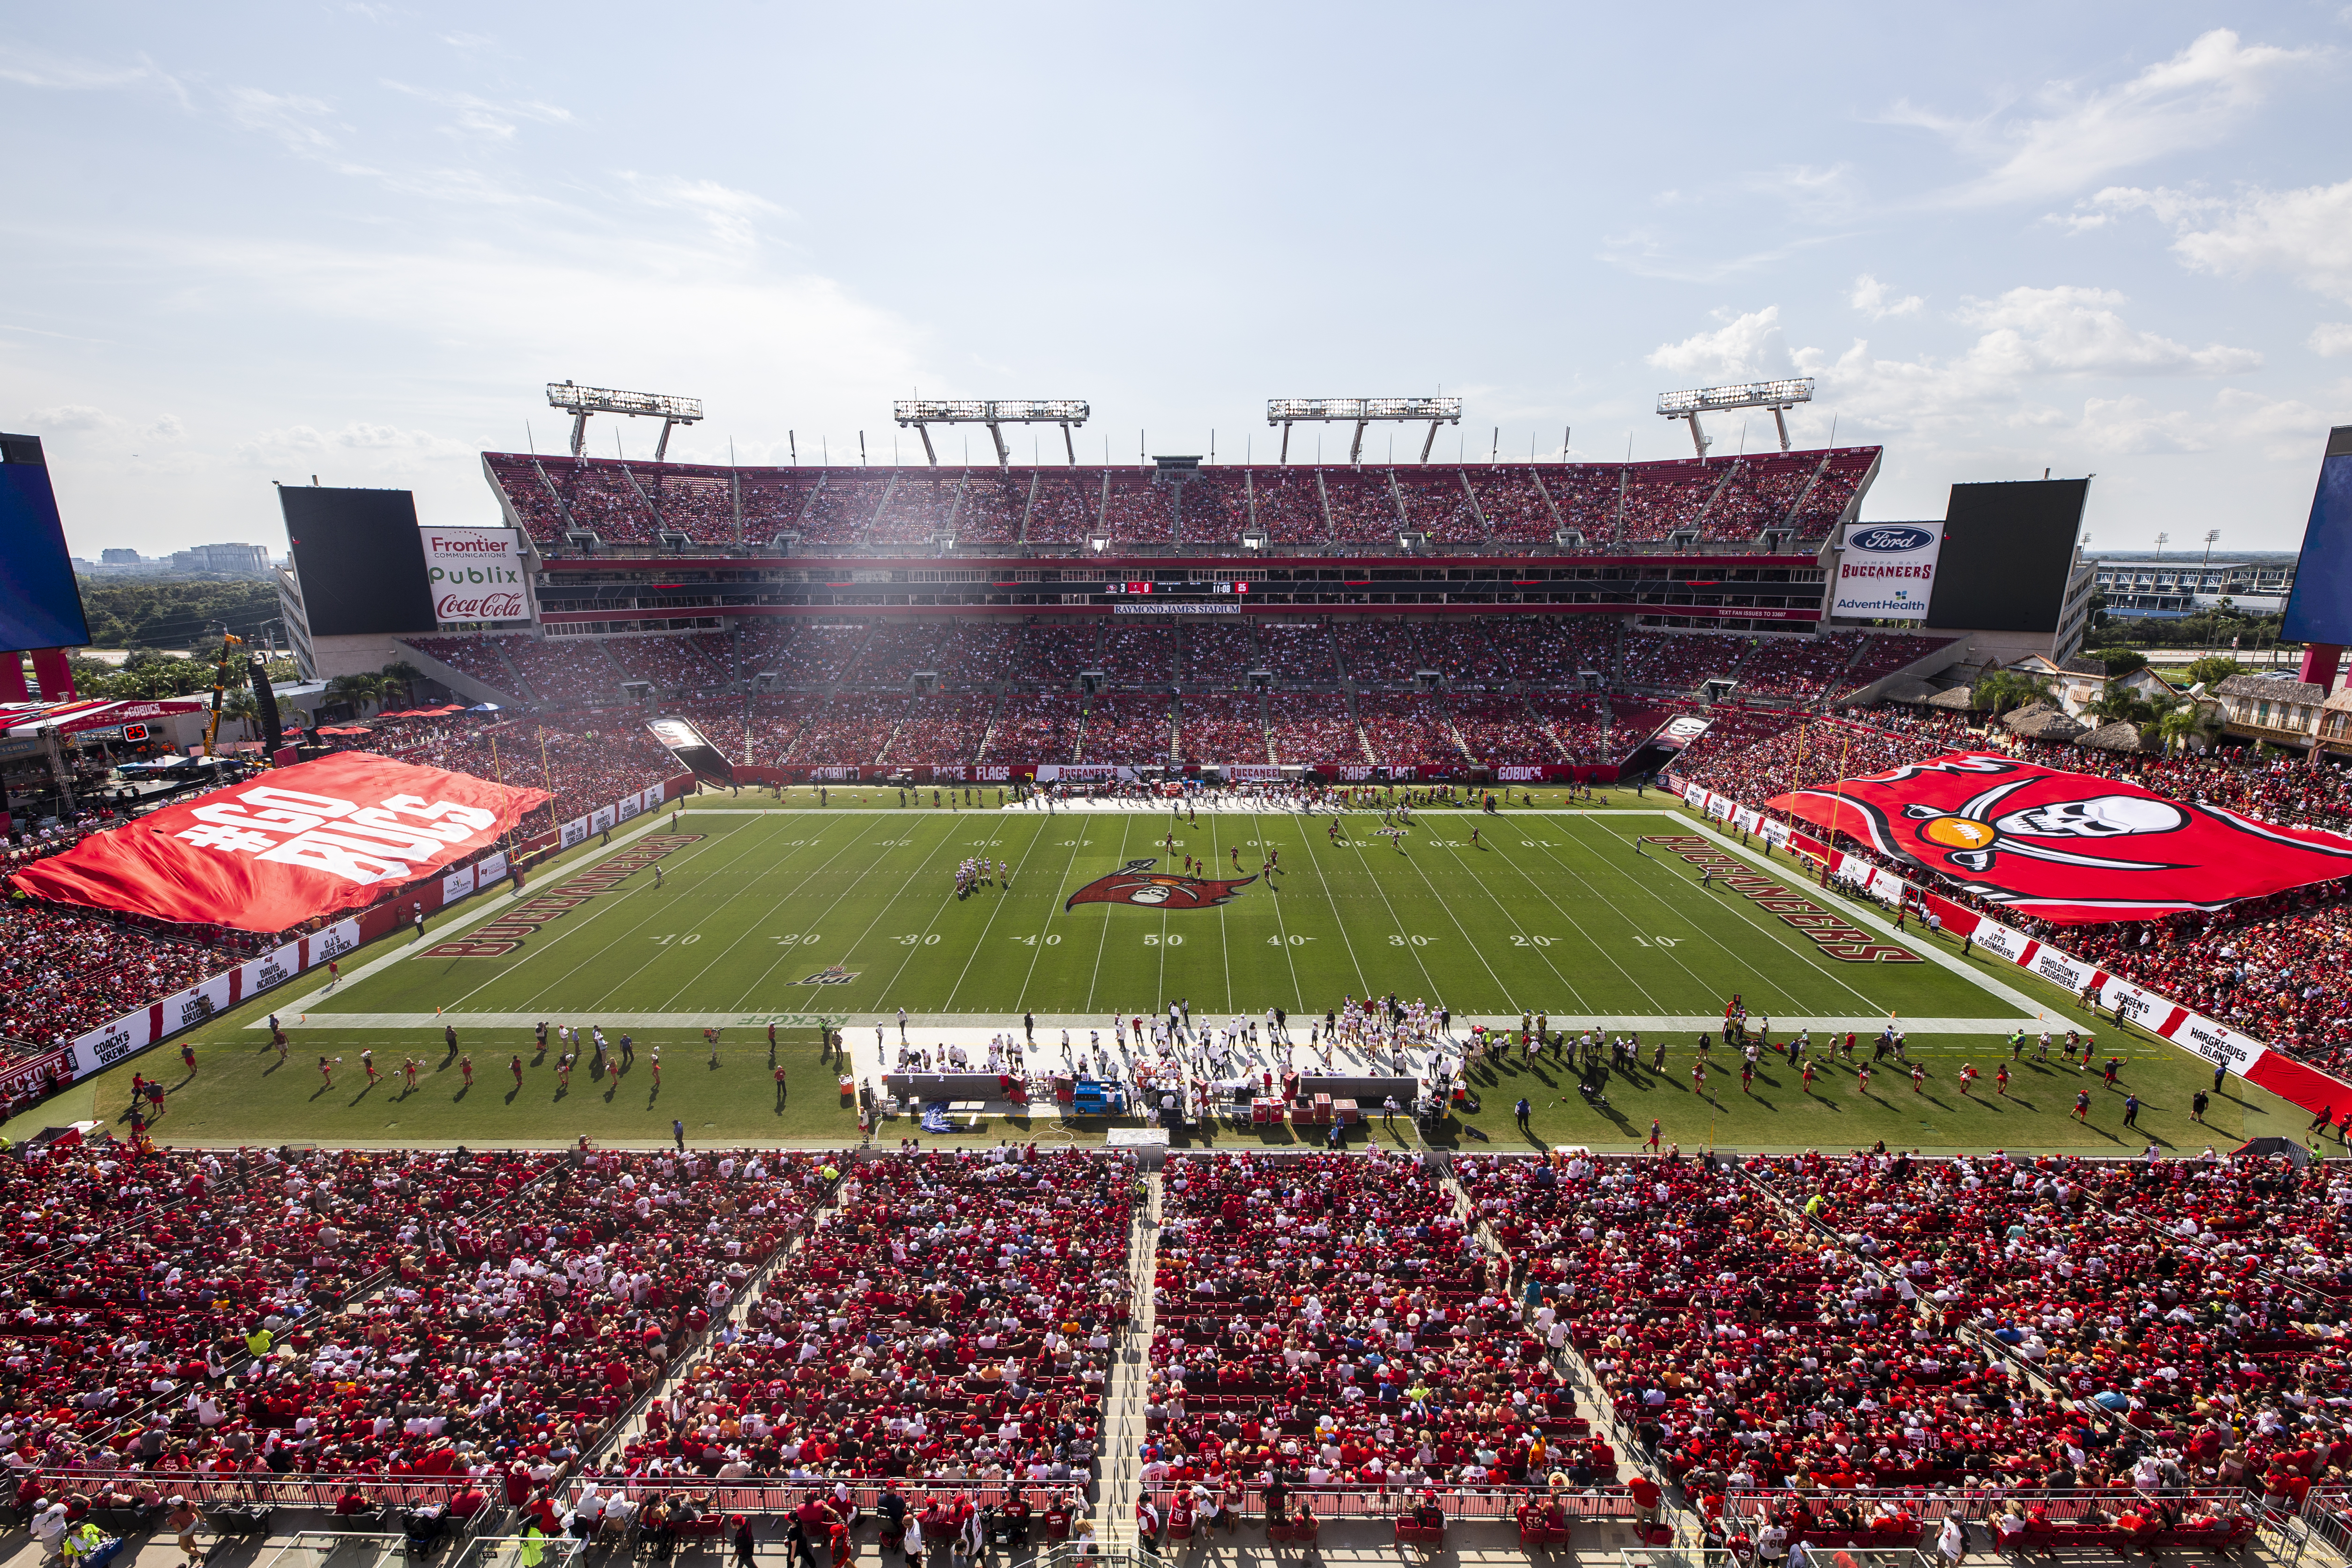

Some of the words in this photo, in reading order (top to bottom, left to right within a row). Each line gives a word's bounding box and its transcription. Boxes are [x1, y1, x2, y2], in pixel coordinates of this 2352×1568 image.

[432, 537, 508, 552] Frontier
[1865, 531, 1916, 547] Ford
[429, 566, 518, 584] Publix
[1842, 564, 1933, 582] BUCCANEERS
[1120, 584, 1125, 592] 3
[1144, 584, 1149, 592] 0
[1238, 583, 1246, 592] 25
[437, 592, 524, 618] Coca-Cola
[124, 703, 160, 717] #GOBUCS
[127, 727, 144, 739] 25
[2254, 731, 2294, 740] GALLEY
[976, 767, 1010, 780] FLAGS
[1058, 767, 1117, 779] BUCCANEERS
[1339, 767, 1373, 780] RAISE
[1669, 778, 1682, 793] KICKOFF
[254, 794, 497, 886] BUCS
[565, 829, 576, 838] EVANS'
[567, 835, 576, 844] ZONE
[1763, 826, 1772, 835] JAMEIS
[1773, 830, 1787, 842] WINSTON'S
[509, 851, 518, 864] 25
[488, 863, 504, 872] BUCCANEERS
[489, 866, 505, 875] FOUNDATION
[411, 835, 703, 959] BUCCANEERS
[1642, 835, 1924, 963] BUCCANEERS
[1906, 888, 1917, 902] 25
[324, 935, 340, 948] O.J.'S
[655, 934, 701, 945] 10
[777, 934, 821, 945] 20
[900, 934, 941, 945] 30
[1021, 934, 1061, 945] 40
[1144, 935, 1183, 946] 50
[1267, 935, 1305, 946] 40
[1389, 935, 1427, 946] 30
[1510, 935, 1551, 946] 20
[1632, 935, 1675, 947] 10
[1990, 932, 2006, 945] J.P.P'S
[319, 945, 336, 961] JUICE
[337, 939, 351, 954] PACK
[1978, 935, 2014, 959] PLAYMAKERS
[259, 962, 280, 978] DAVIS
[2041, 955, 2079, 981] GHOLSTON'S
[256, 968, 288, 990] ACADEMY
[2039, 965, 2076, 989] CRUSADERS
[2114, 991, 2149, 1013] JENSEN'S
[737, 1015, 851, 1025] KICKOFF
[94, 1030, 130, 1055] COACH'S
[2190, 1027, 2247, 1062] HARGREAVES
[67, 1052, 76, 1067] 2019
[99, 1042, 131, 1064] KREWE
[2199, 1043, 2231, 1065] ISLAND
[742, 1422, 755, 1433] 19
[891, 1429, 902, 1438] 81
[1189, 1431, 1199, 1440] 10
[1928, 1437, 1940, 1447] 18
[1206, 1454, 1216, 1462] 85
[1270, 1496, 1283, 1507] 80
[1426, 1517, 1436, 1528] 10
[1526, 1516, 1539, 1528] 55
[1709, 1532, 1723, 1542] TOUCH
[2287, 1531, 2299, 1544] 137
